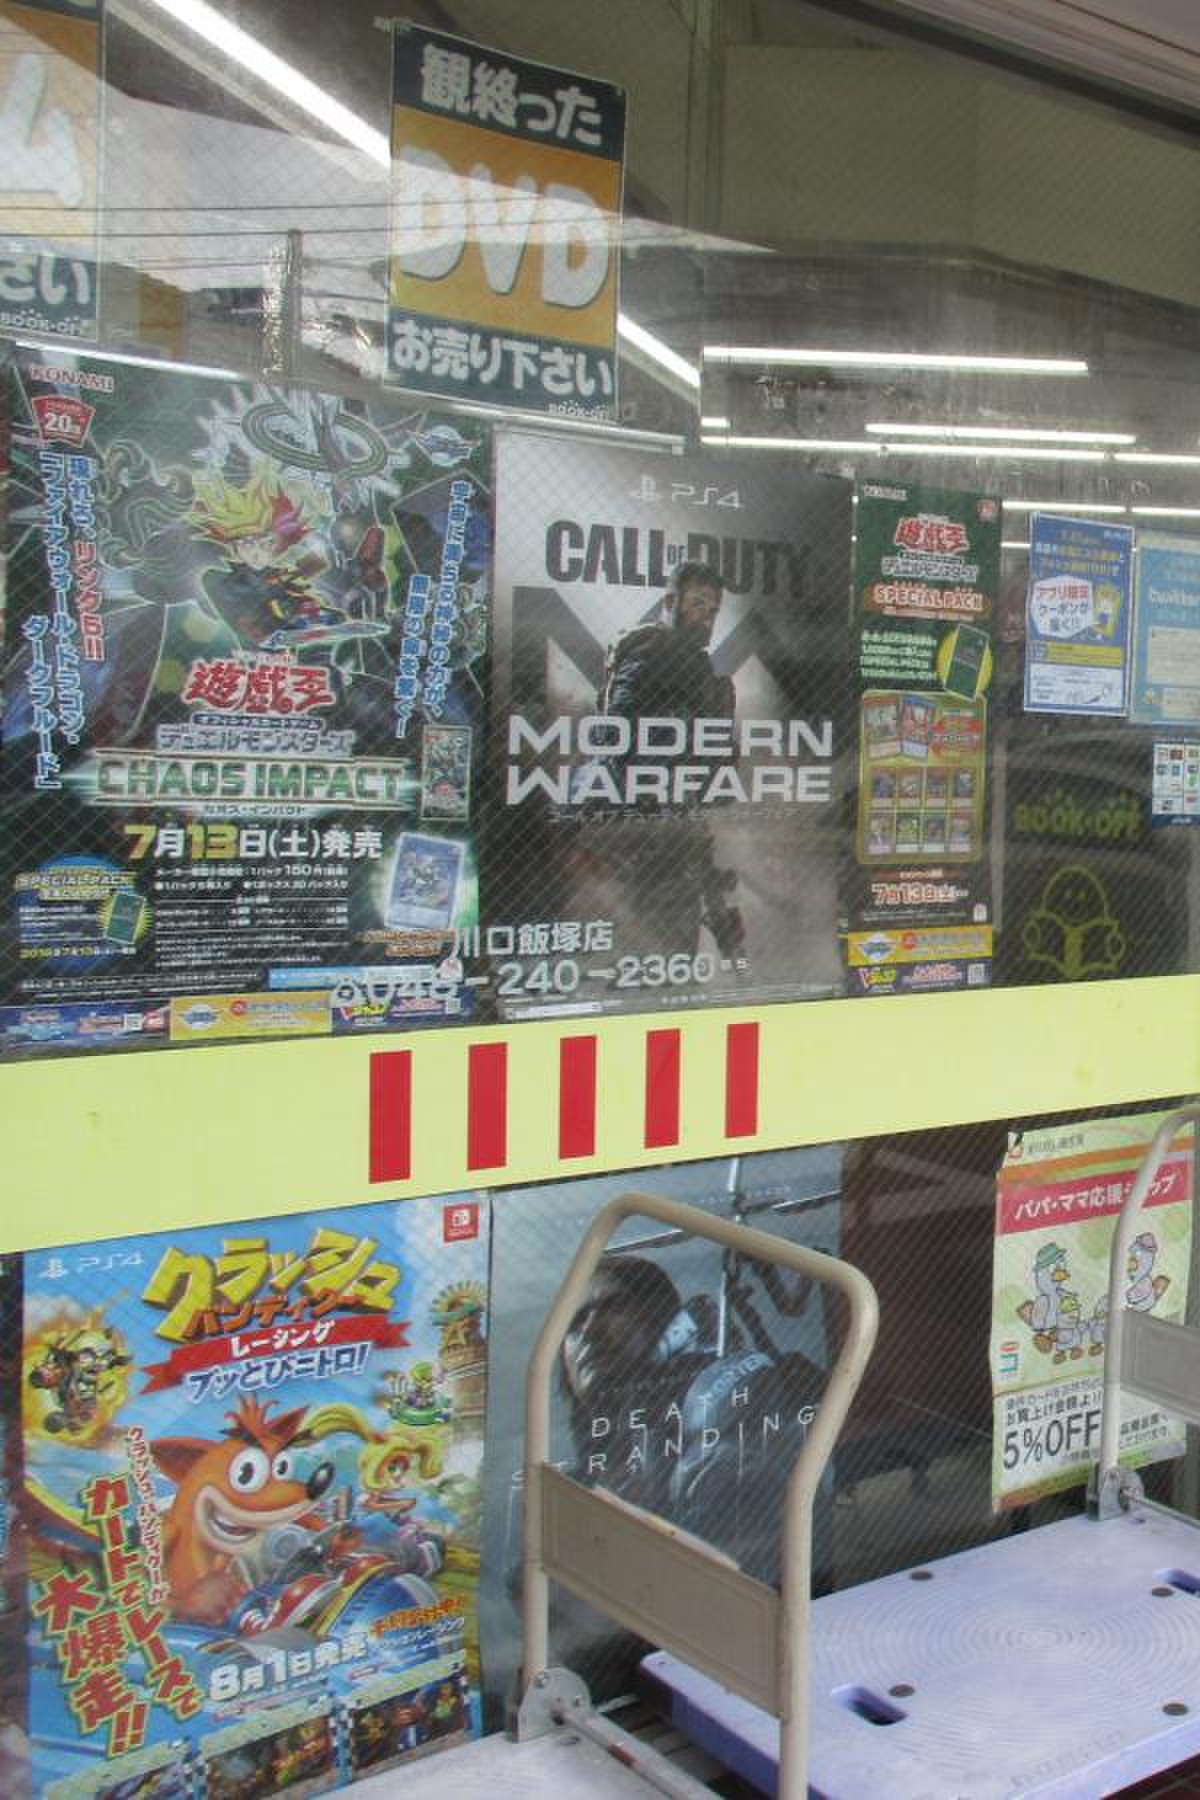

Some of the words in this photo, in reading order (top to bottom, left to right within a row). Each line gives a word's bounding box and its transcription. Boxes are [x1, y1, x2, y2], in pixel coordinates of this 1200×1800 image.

[421, 43, 603, 146] 観終った
[397, 144, 610, 310] DVD
[31, 366, 113, 392] KONAMI
[393, 318, 613, 398] お売り下さい
[672, 482, 742, 509] PS4
[546, 520, 668, 587] CALL
[183, 659, 336, 714] 遊戯王
[158, 725, 353, 754] デュエルモンスターズ
[508, 714, 833, 757] MODERN
[99, 761, 244, 799] CHAOS
[253, 761, 404, 799] IMPACT
[506, 764, 832, 805] WARFARE
[124, 823, 383, 861] 7月13日(土)発売
[455, 921, 615, 959] 川口飯塚店
[1015, 1171, 1178, 1221] パパ・ママ応援ップ
[77, 1250, 145, 1273] PS4
[142, 1227, 401, 1343] クラッシュ
[184, 1288, 362, 1340] バンディクー
[231, 1320, 336, 1358] レーシング
[592, 1386, 750, 1438] DEATH
[1003, 1409, 1102, 1470] 5%OFF
[210, 1632, 368, 1701] 8月1日発売
